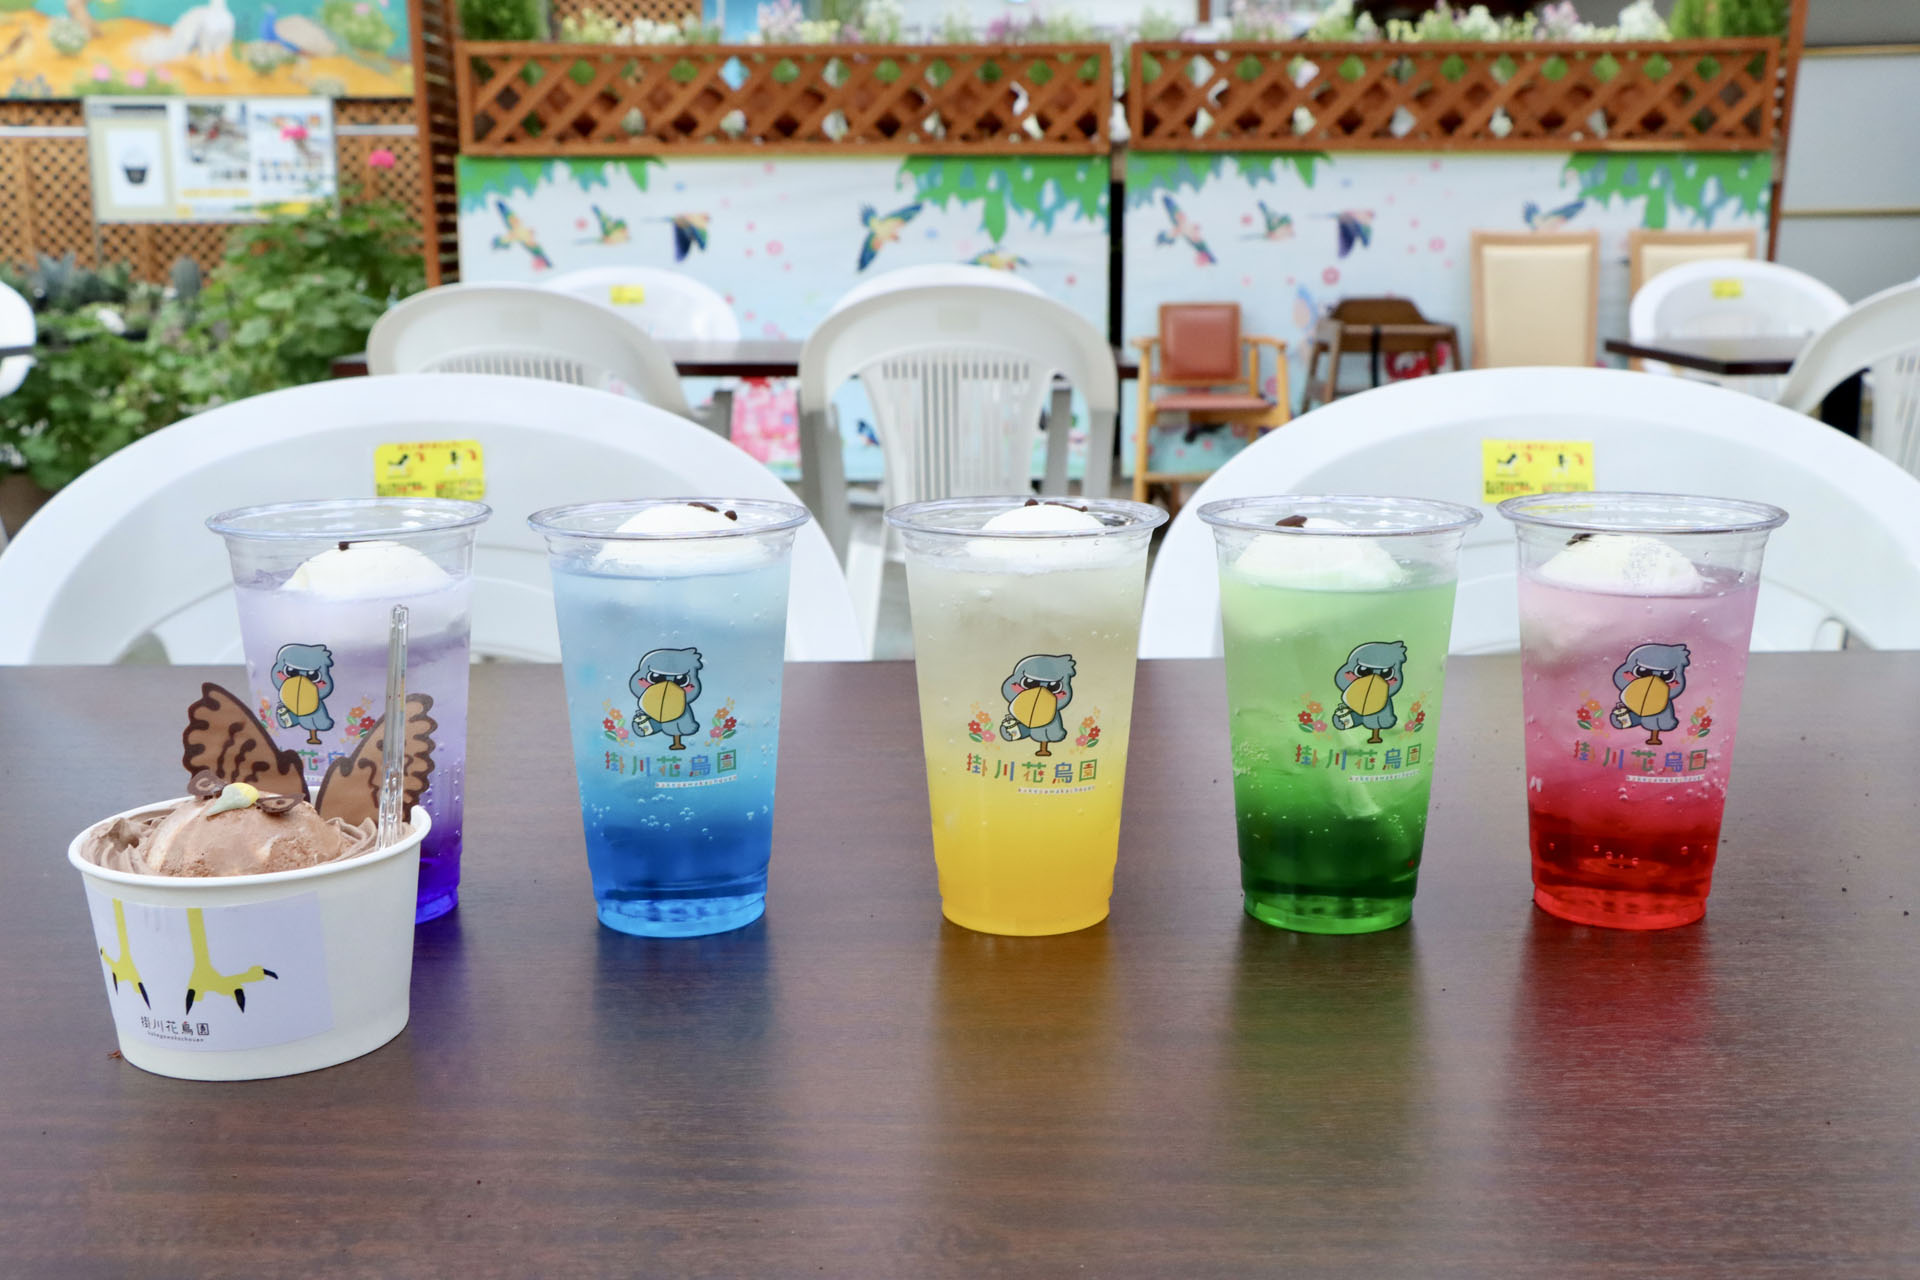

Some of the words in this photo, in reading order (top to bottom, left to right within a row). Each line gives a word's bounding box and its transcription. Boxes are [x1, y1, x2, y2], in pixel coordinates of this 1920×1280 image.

[604, 749, 737, 777] 掛川花鳥園
[966, 752, 1098, 784] 掛川花鳥園
[1295, 743, 1422, 771] 掛川花鳥園
[140, 1016, 210, 1037] 掛川花鳥園
